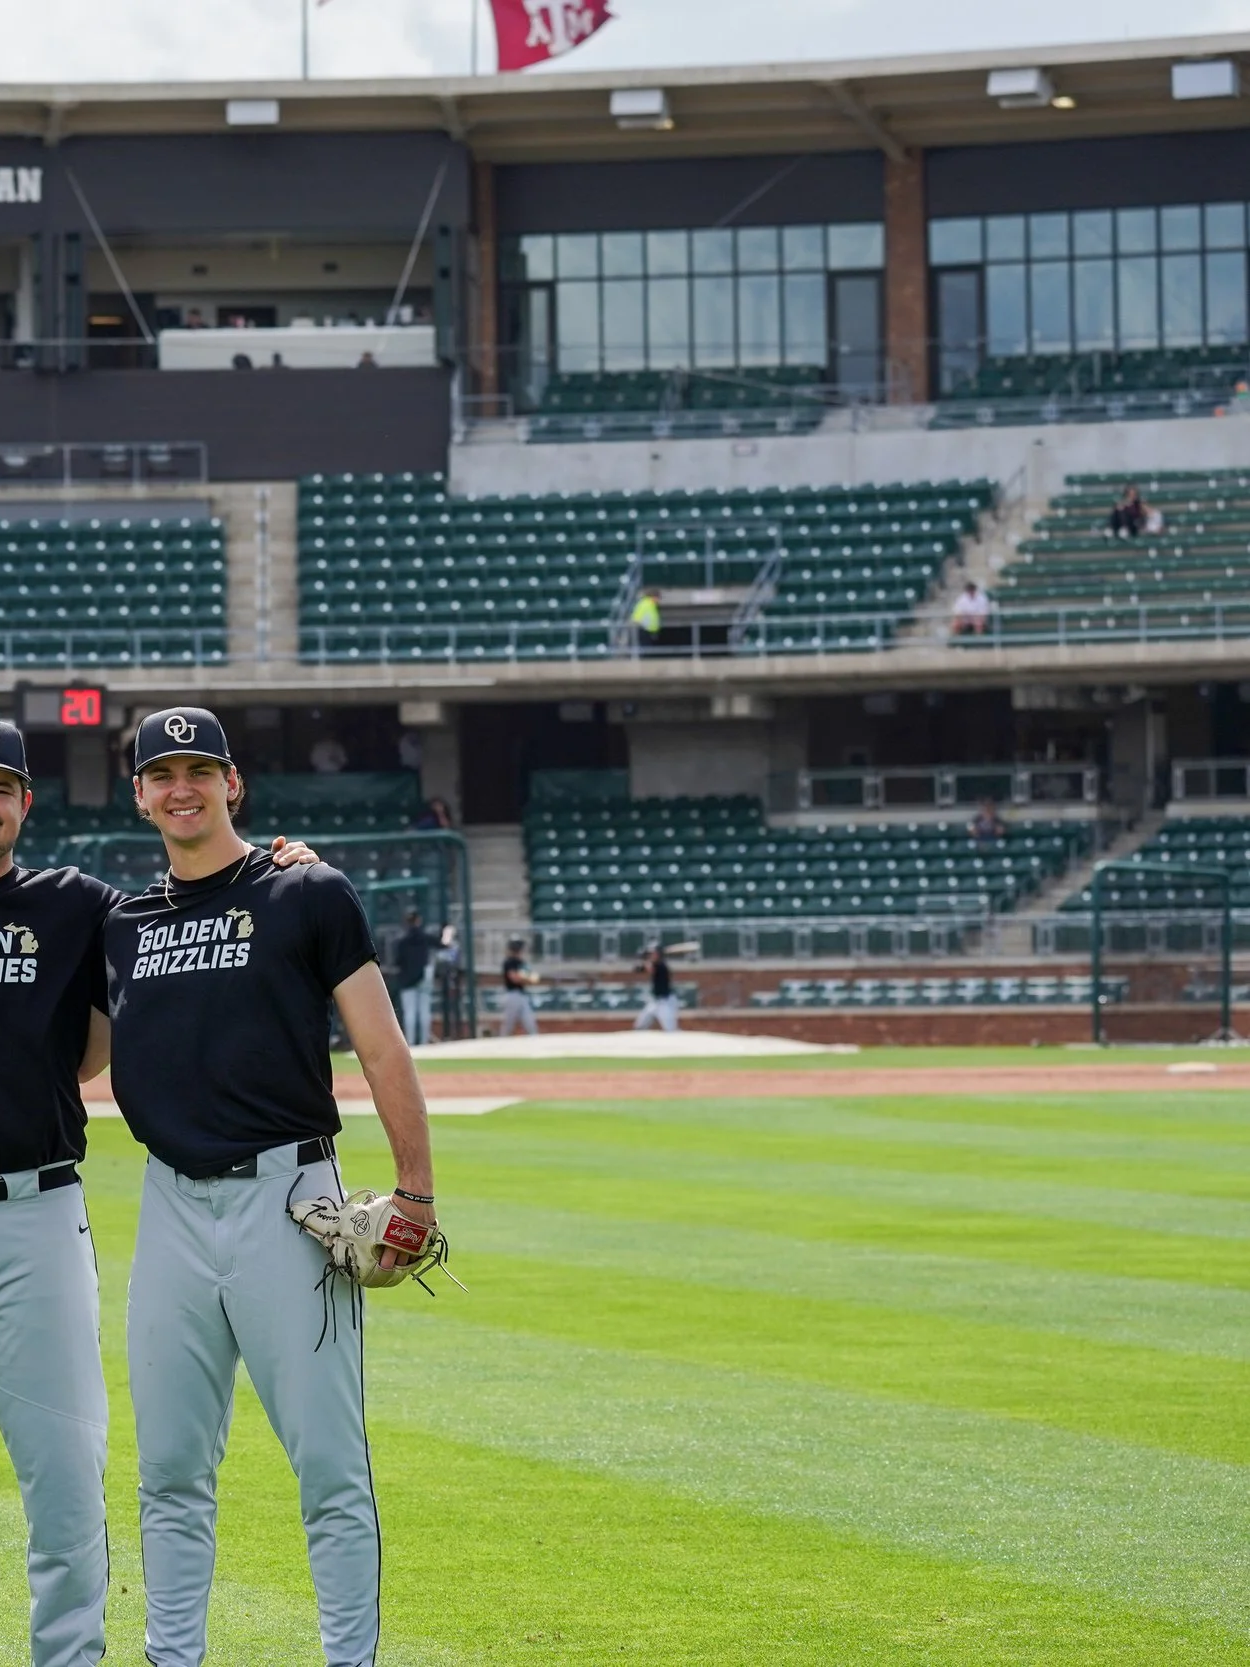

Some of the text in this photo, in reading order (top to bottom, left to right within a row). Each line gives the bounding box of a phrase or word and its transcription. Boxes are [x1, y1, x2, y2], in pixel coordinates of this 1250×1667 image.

[61, 689, 101, 726] 20
[164, 715, 198, 744] OU
[137, 916, 233, 954] GOLDEN
[132, 942, 251, 980] GRIZZLIES
